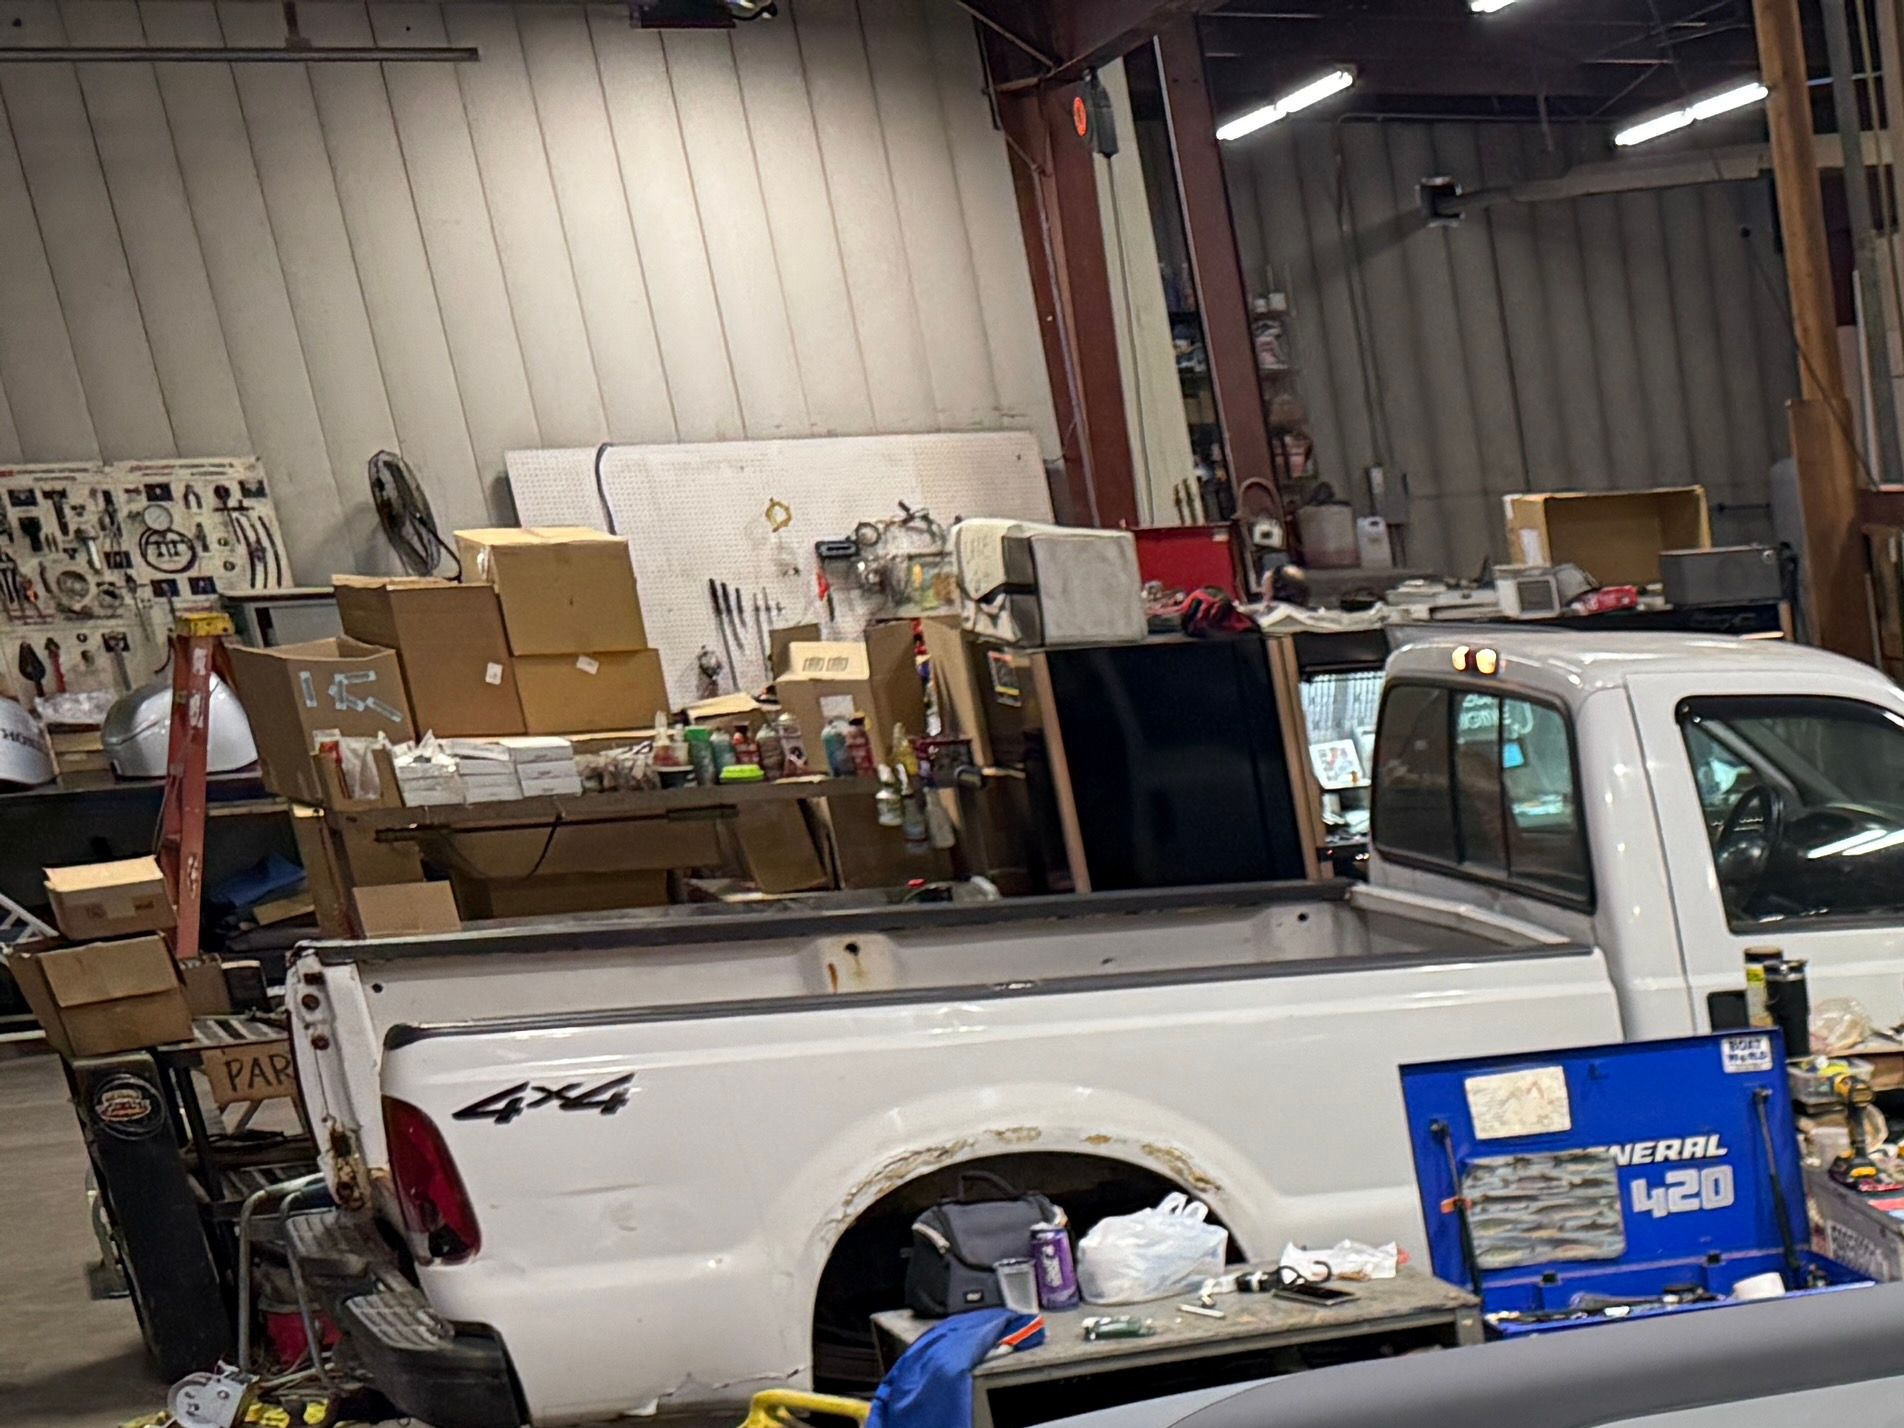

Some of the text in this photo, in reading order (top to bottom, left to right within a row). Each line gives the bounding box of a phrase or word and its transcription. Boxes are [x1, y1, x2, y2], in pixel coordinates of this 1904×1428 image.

[223, 1053, 294, 1093] PAR
[1584, 1134, 1729, 1167] NERAL
[1630, 1164, 1736, 1219] 420
